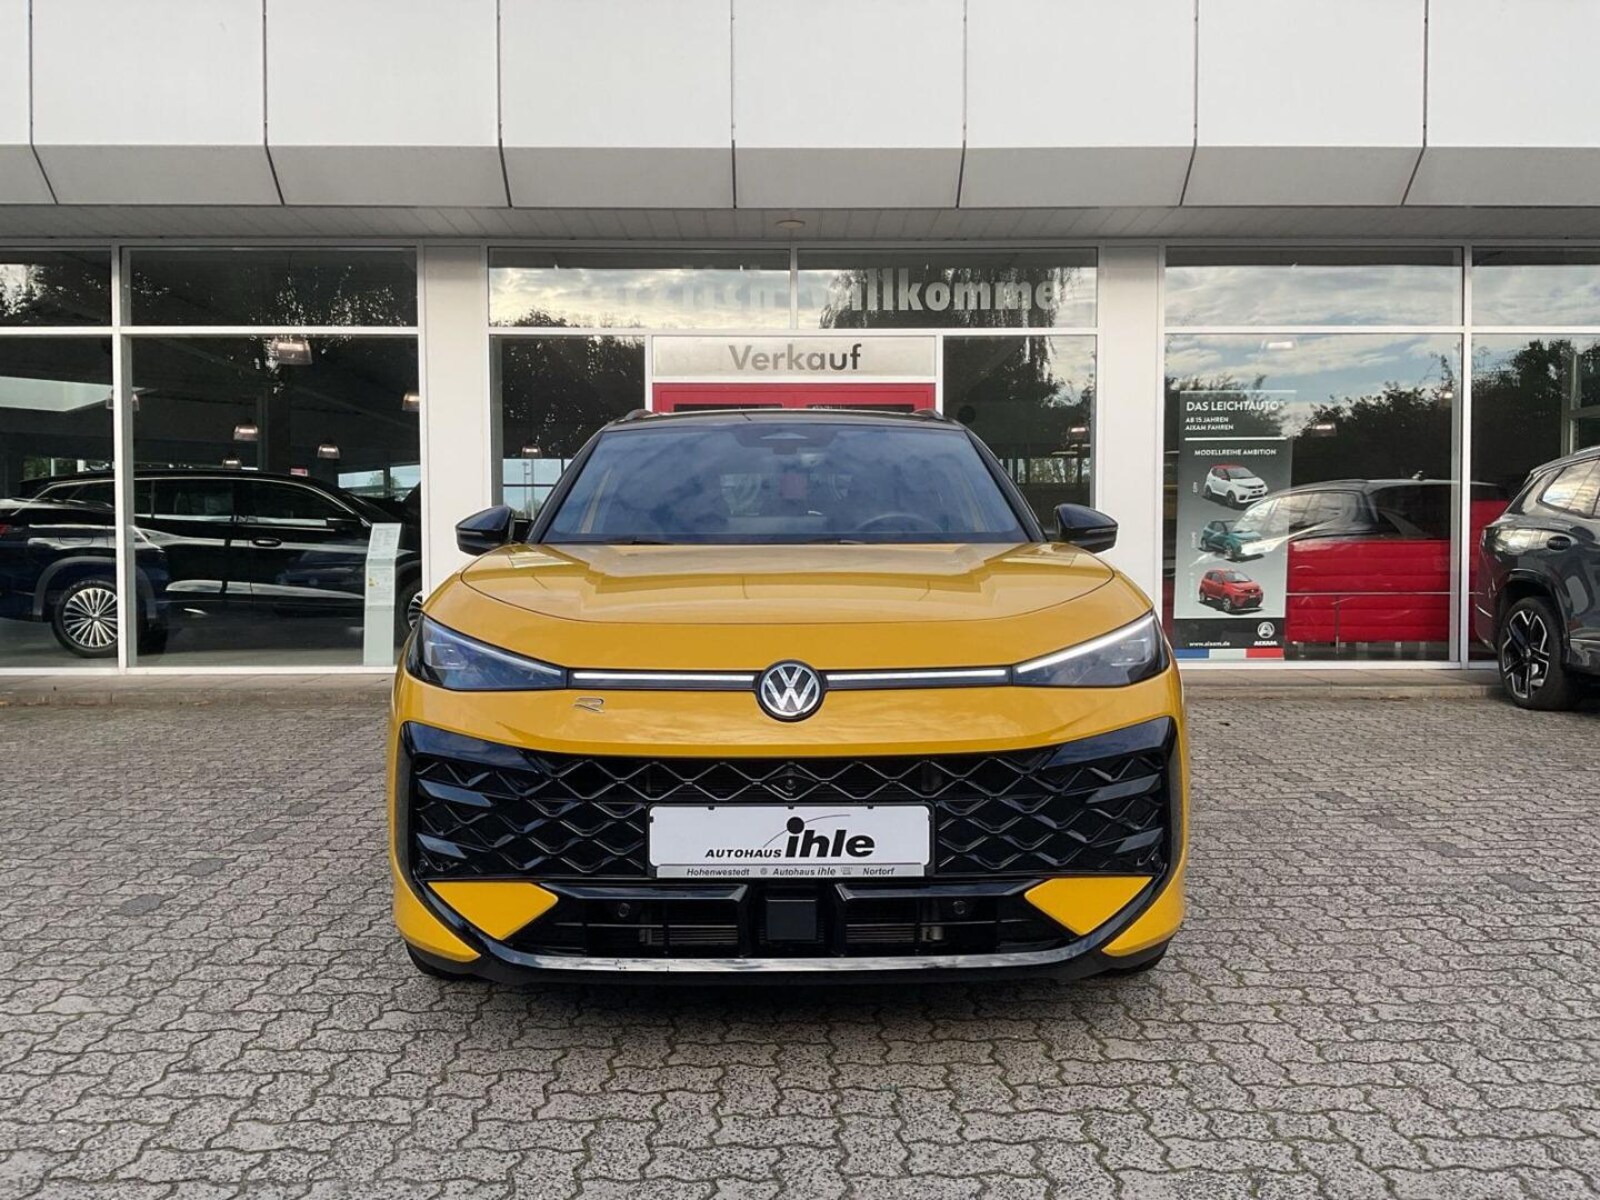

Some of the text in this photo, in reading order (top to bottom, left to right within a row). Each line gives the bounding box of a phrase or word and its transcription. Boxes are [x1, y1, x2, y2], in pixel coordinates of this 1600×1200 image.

[729, 344, 862, 371] Verkauf
[1186, 401, 1209, 411] DAS
[1194, 448, 1241, 456] MODELLREIHE
[705, 816, 875, 858] AUTOHAUS ihle
[686, 867, 750, 876] Hohenwestedt
[772, 867, 815, 876] Autohaus
[862, 867, 895, 876] Nortorf
